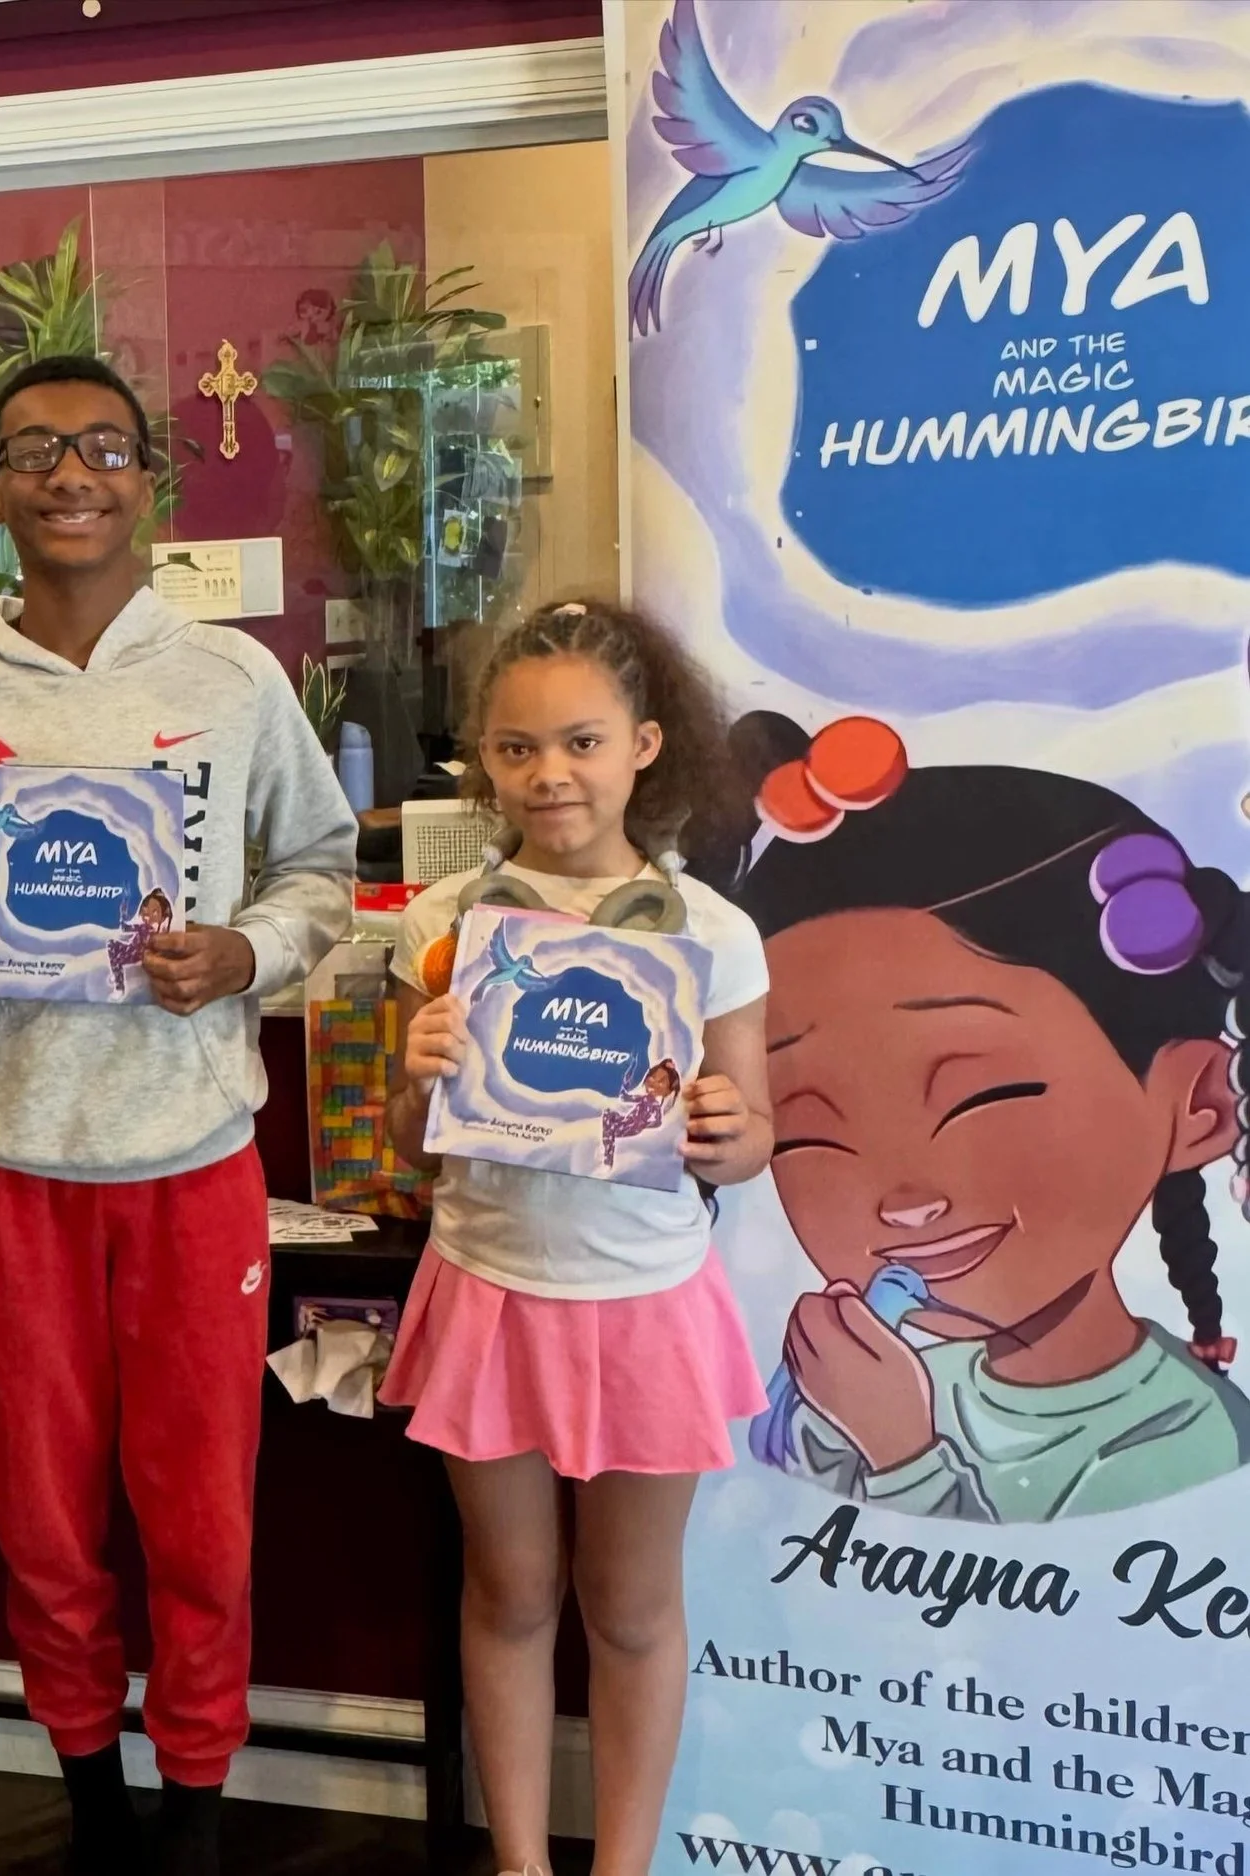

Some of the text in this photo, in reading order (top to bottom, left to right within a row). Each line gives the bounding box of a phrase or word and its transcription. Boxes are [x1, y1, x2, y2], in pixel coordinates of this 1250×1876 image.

[917, 211, 1210, 329] MYA
[1001, 332, 1126, 361] AND THE
[993, 360, 1134, 398] MAGIC
[35, 840, 98, 865] MYA
[14, 882, 124, 898] HUMMINGBIRD
[541, 997, 609, 1029] MYA
[513, 1037, 630, 1065] HUMMINGBIRD
[770, 1504, 1250, 1640] Arayna Ke
[691, 1639, 862, 1697] Author
[879, 1670, 933, 1707] of
[946, 1677, 1026, 1721] the
[821, 1714, 925, 1768] Mya
[941, 1746, 1032, 1784] and
[1053, 1753, 1134, 1799] the
[881, 1781, 1247, 1876] Hummingbird
